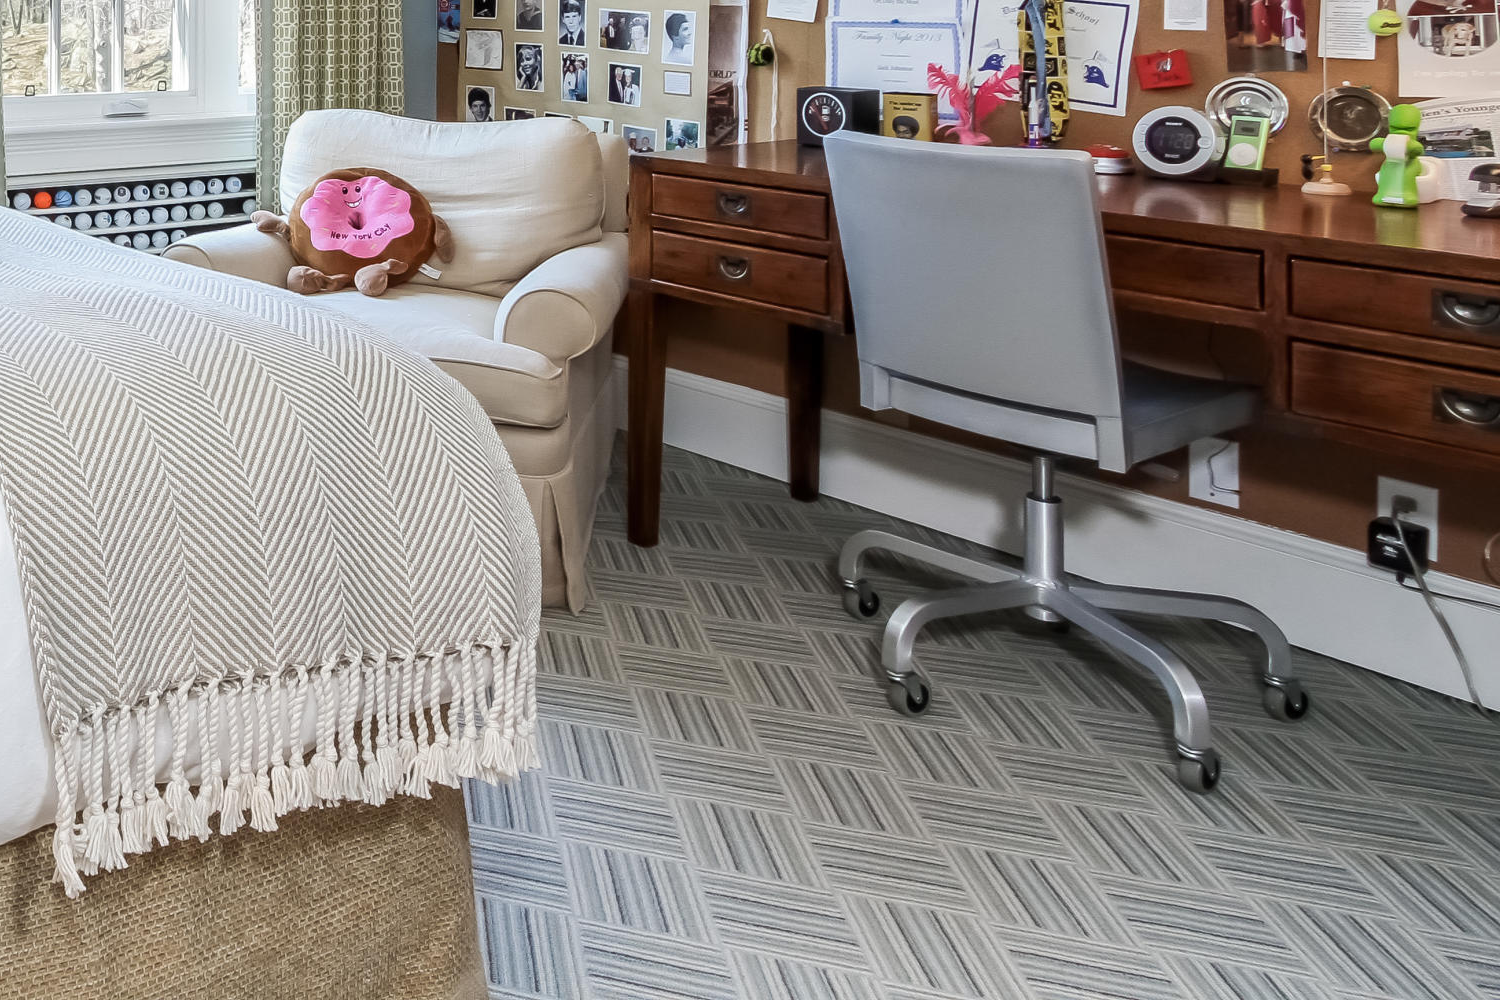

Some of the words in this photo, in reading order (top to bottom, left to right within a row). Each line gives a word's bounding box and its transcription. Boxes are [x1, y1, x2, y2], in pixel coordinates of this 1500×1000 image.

[1066, 6, 1100, 25] School
[709, 70, 734, 79] ORLD
[1421, 109, 1452, 118] ien's
[330, 230, 348, 240] New
